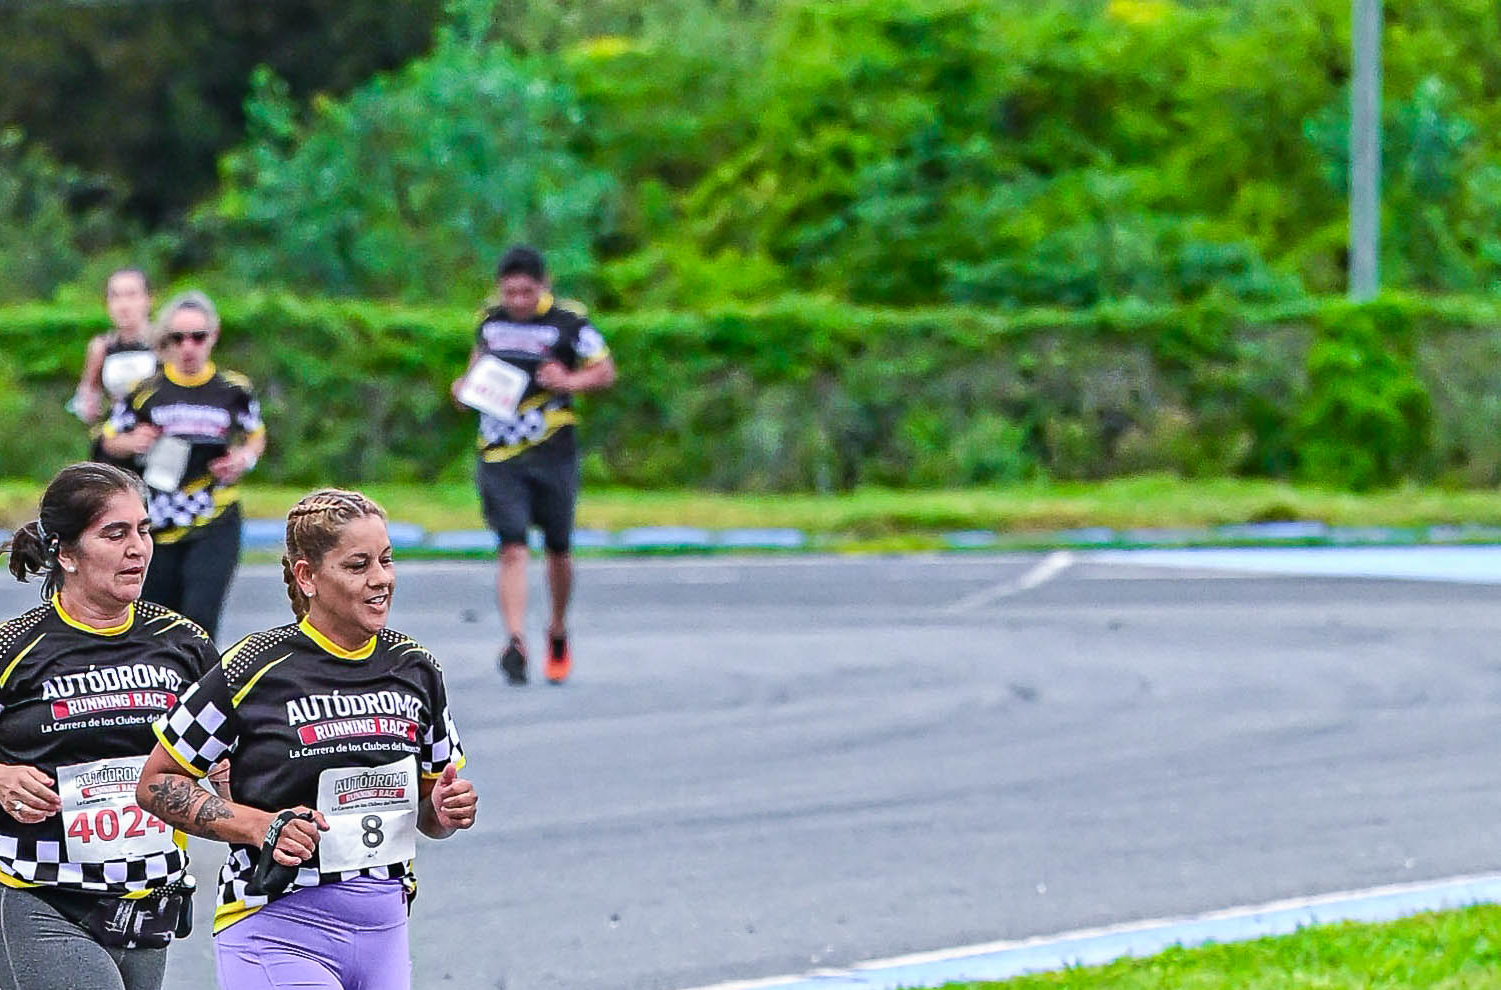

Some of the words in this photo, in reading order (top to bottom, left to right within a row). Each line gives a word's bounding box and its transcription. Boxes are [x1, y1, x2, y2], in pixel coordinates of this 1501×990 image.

[42, 664, 182, 700] AUTÓDROMO
[66, 694, 130, 715] RUNNING
[134, 692, 168, 709] RACE
[286, 690, 423, 726] AUTÓDROMO
[41, 724, 52, 733] La
[53, 720, 86, 731] Carrera
[89, 717, 100, 727] de
[102, 716, 114, 726] los
[116, 714, 145, 725] Clubes
[314, 719, 376, 740] RUNNING
[378, 719, 410, 737] RACE
[290, 749, 300, 758] La
[302, 744, 334, 757] Carrera
[336, 743, 347, 753] de
[349, 742, 361, 751] los
[362, 742, 390, 750] Clubes
[391, 742, 402, 750] del
[75, 765, 141, 788] AUTÓDROM
[334, 771, 409, 795] AUTÓDROMO
[378, 789, 398, 798] RACE
[361, 814, 384, 848] 8
